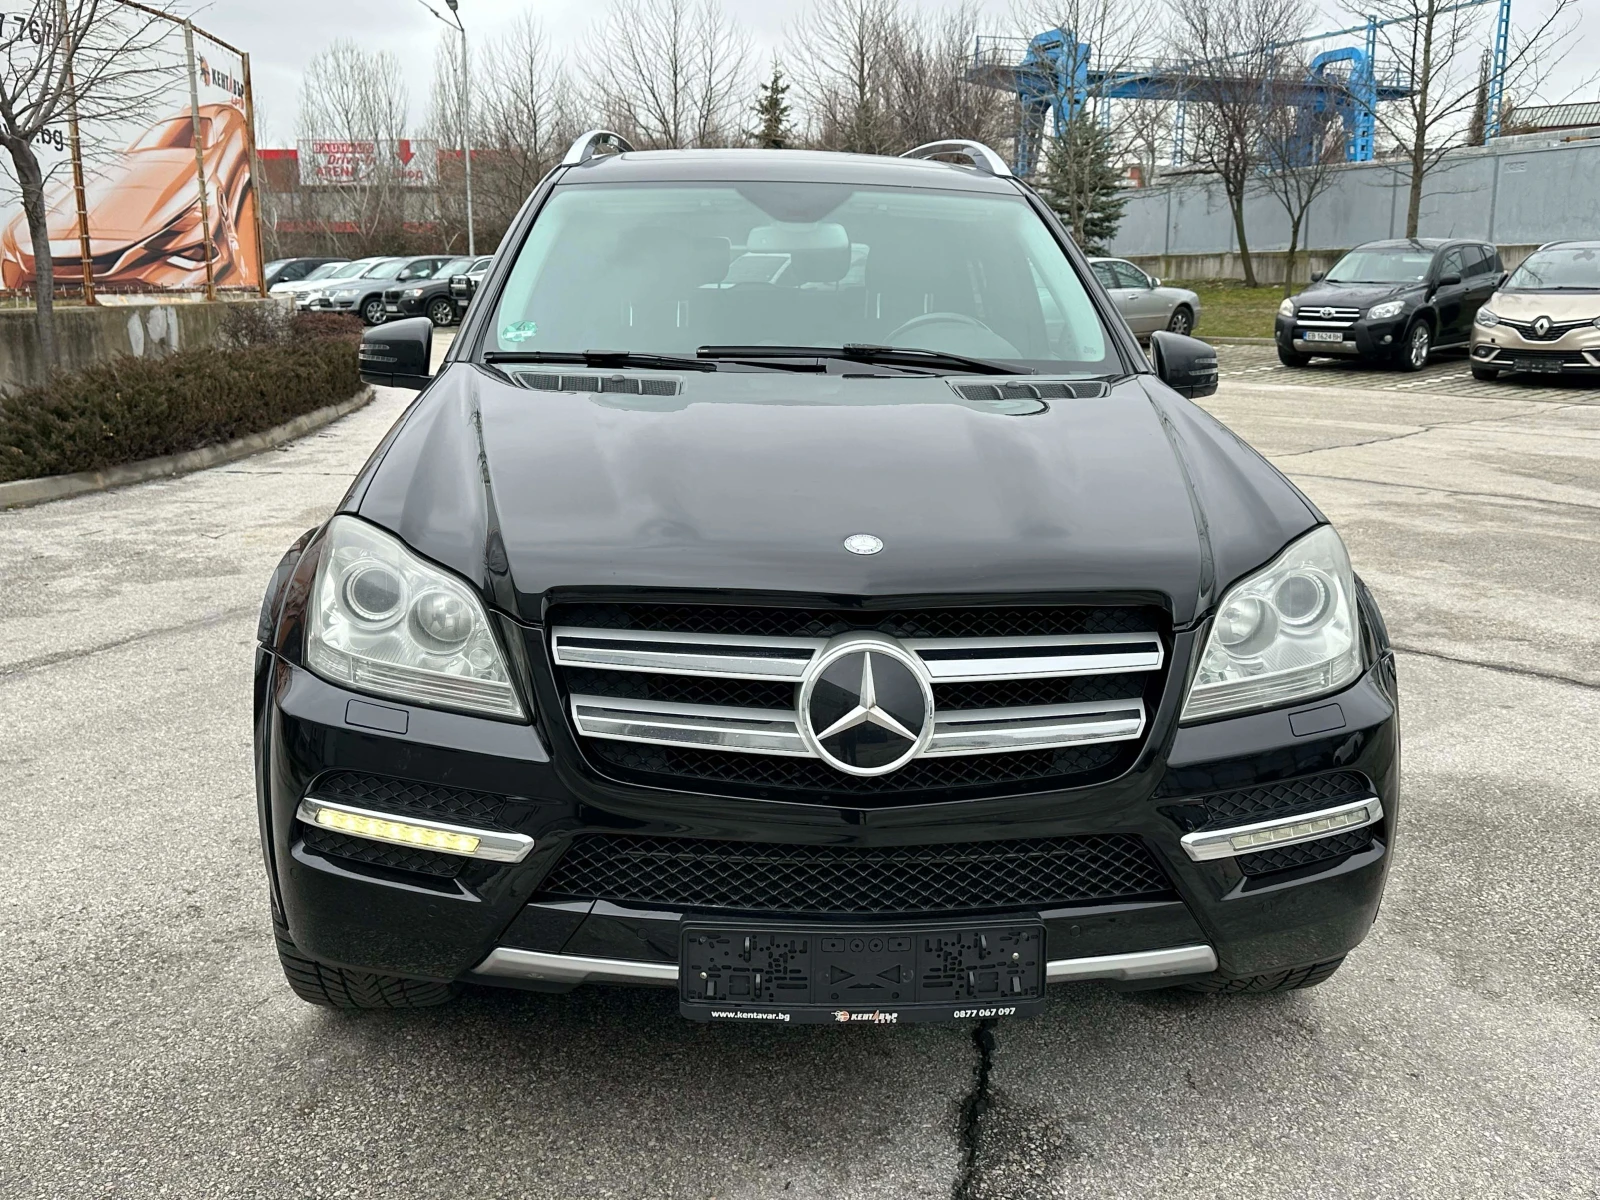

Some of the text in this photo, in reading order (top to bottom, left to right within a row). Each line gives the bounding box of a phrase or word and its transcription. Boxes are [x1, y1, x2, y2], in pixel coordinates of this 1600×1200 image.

[711, 1010, 791, 1021] www.kentavar.bg
[953, 1007, 1016, 1019] 0877 067 097
